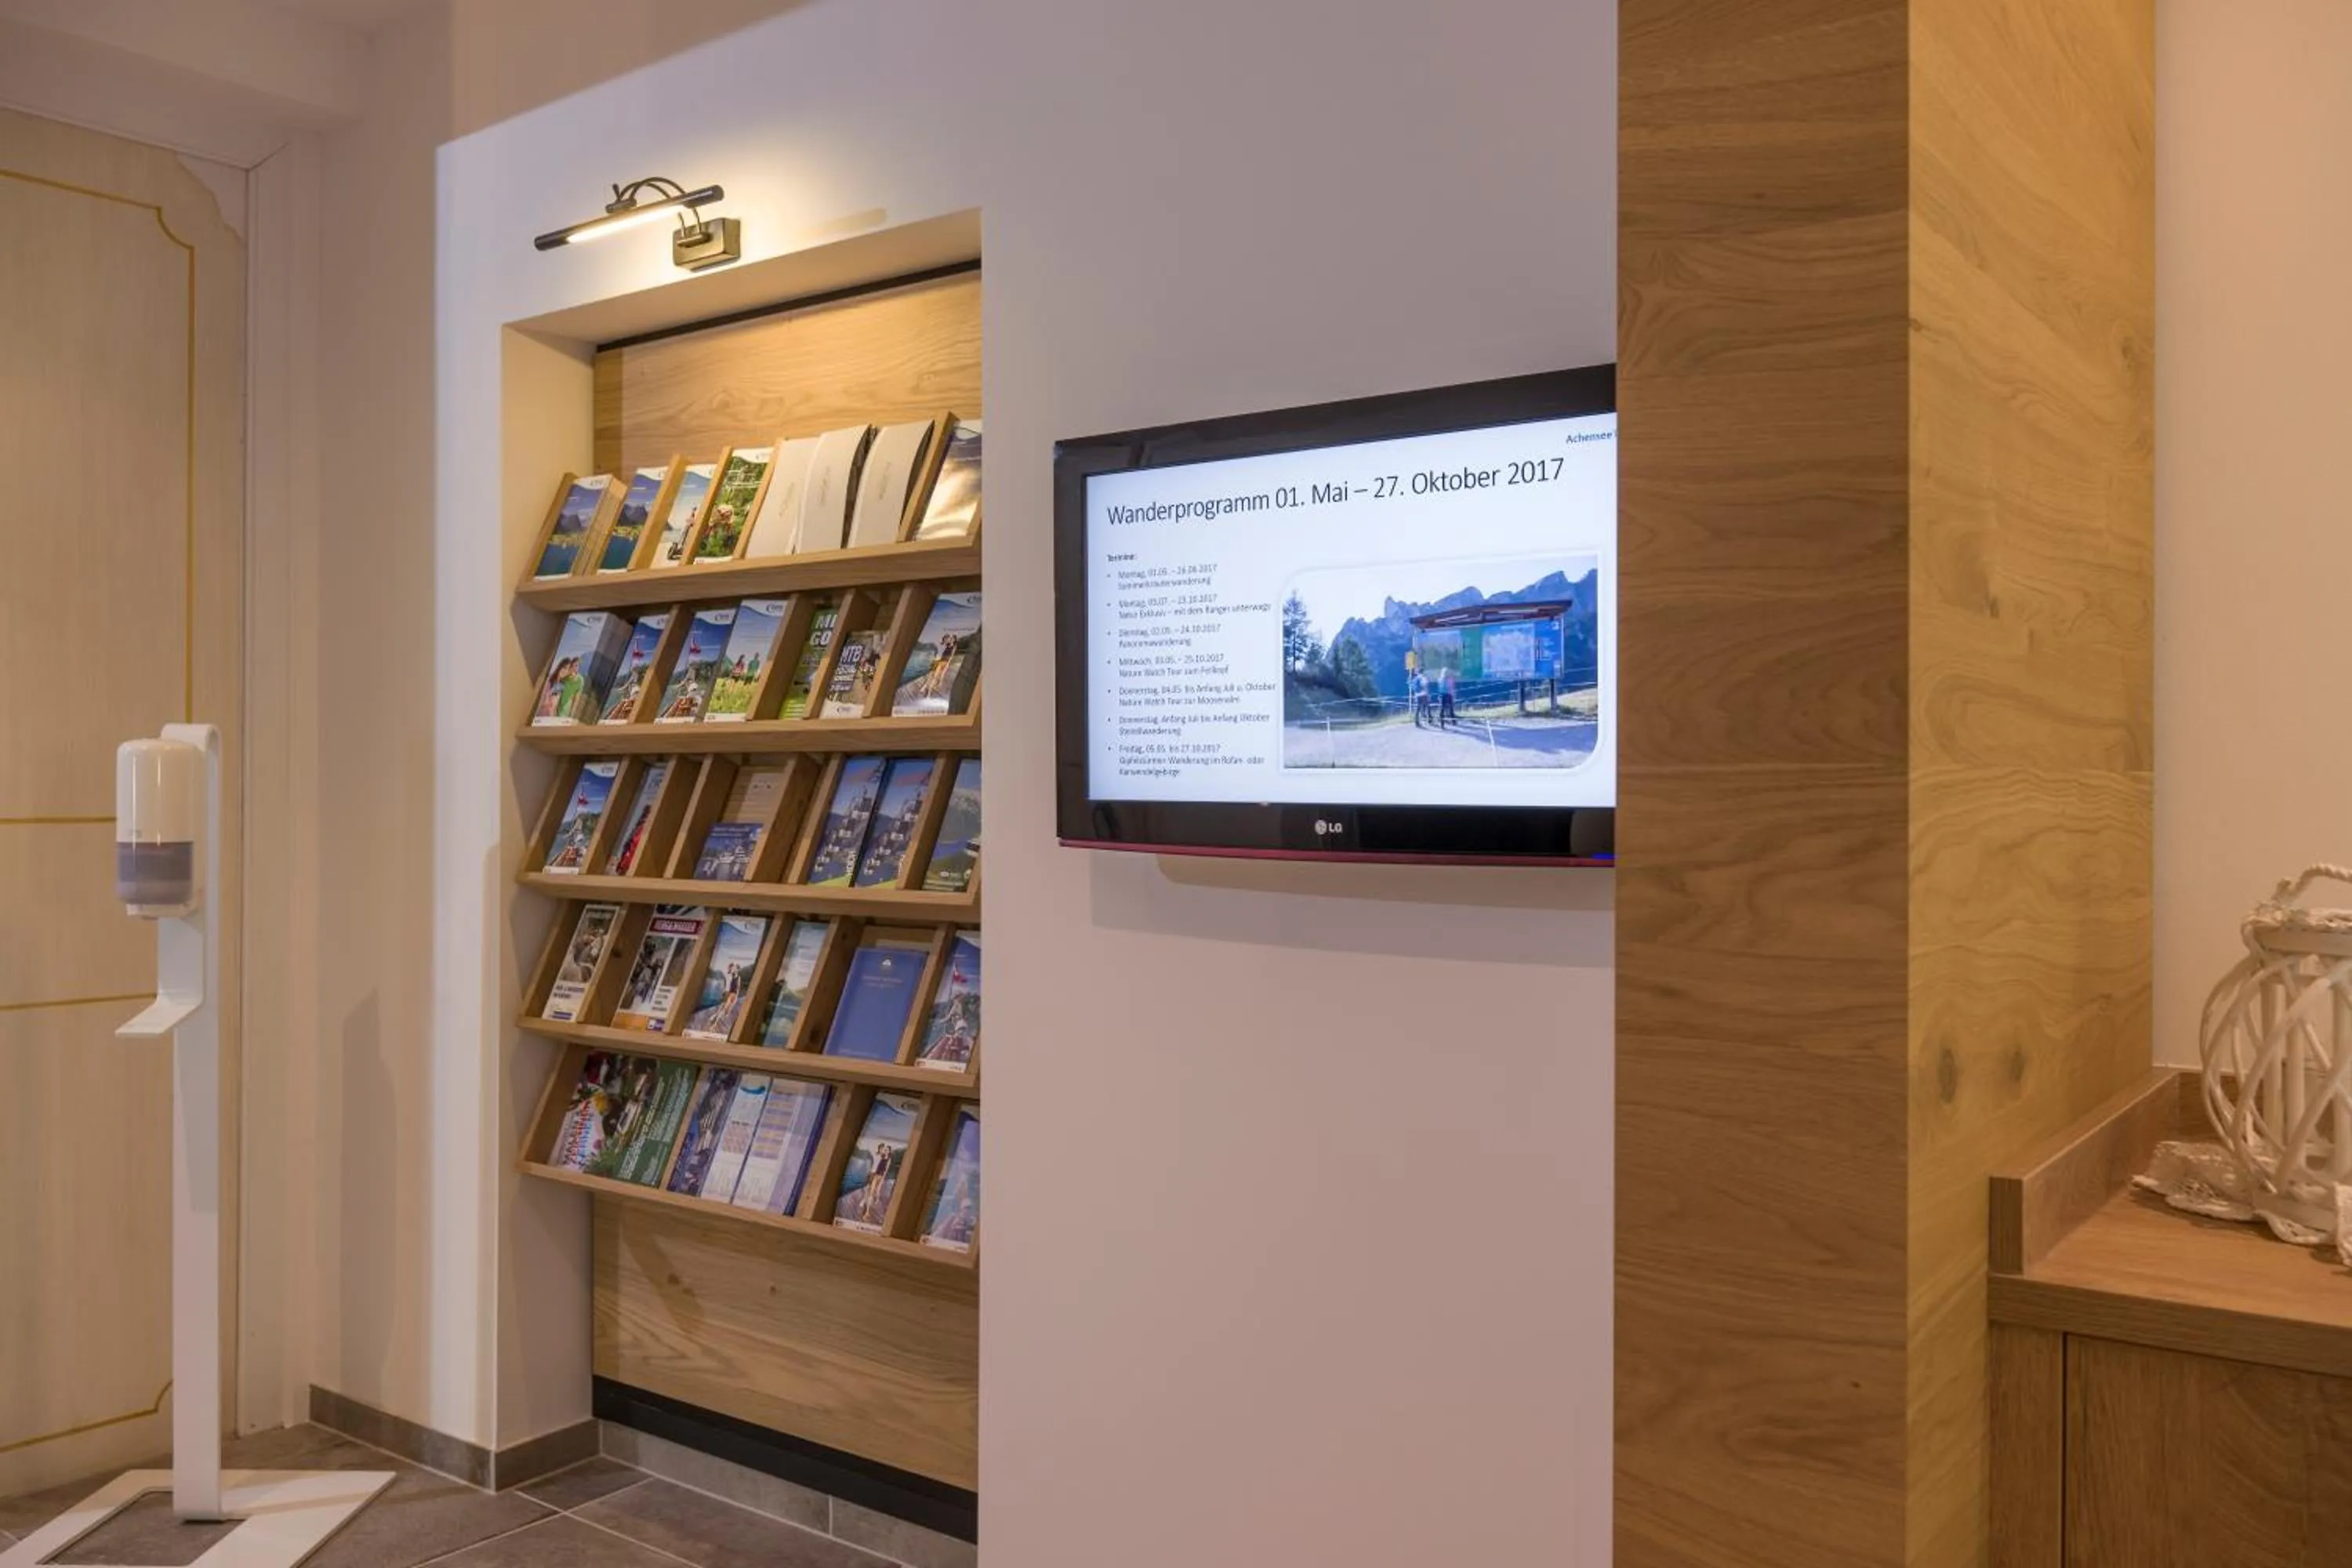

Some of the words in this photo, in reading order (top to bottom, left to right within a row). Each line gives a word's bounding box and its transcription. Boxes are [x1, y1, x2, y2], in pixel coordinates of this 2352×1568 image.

[1566, 432, 1613, 445] Achensee
[1107, 493, 1270, 525] Wanderprogramm
[1276, 487, 1305, 509] 01.
[1312, 481, 1348, 504] Mai
[1374, 476, 1404, 498] 27.
[1412, 466, 1501, 495] Oktober
[1507, 457, 1564, 485] 2017
[809, 630, 833, 646] GO
[1328, 822, 1343, 833] LG
